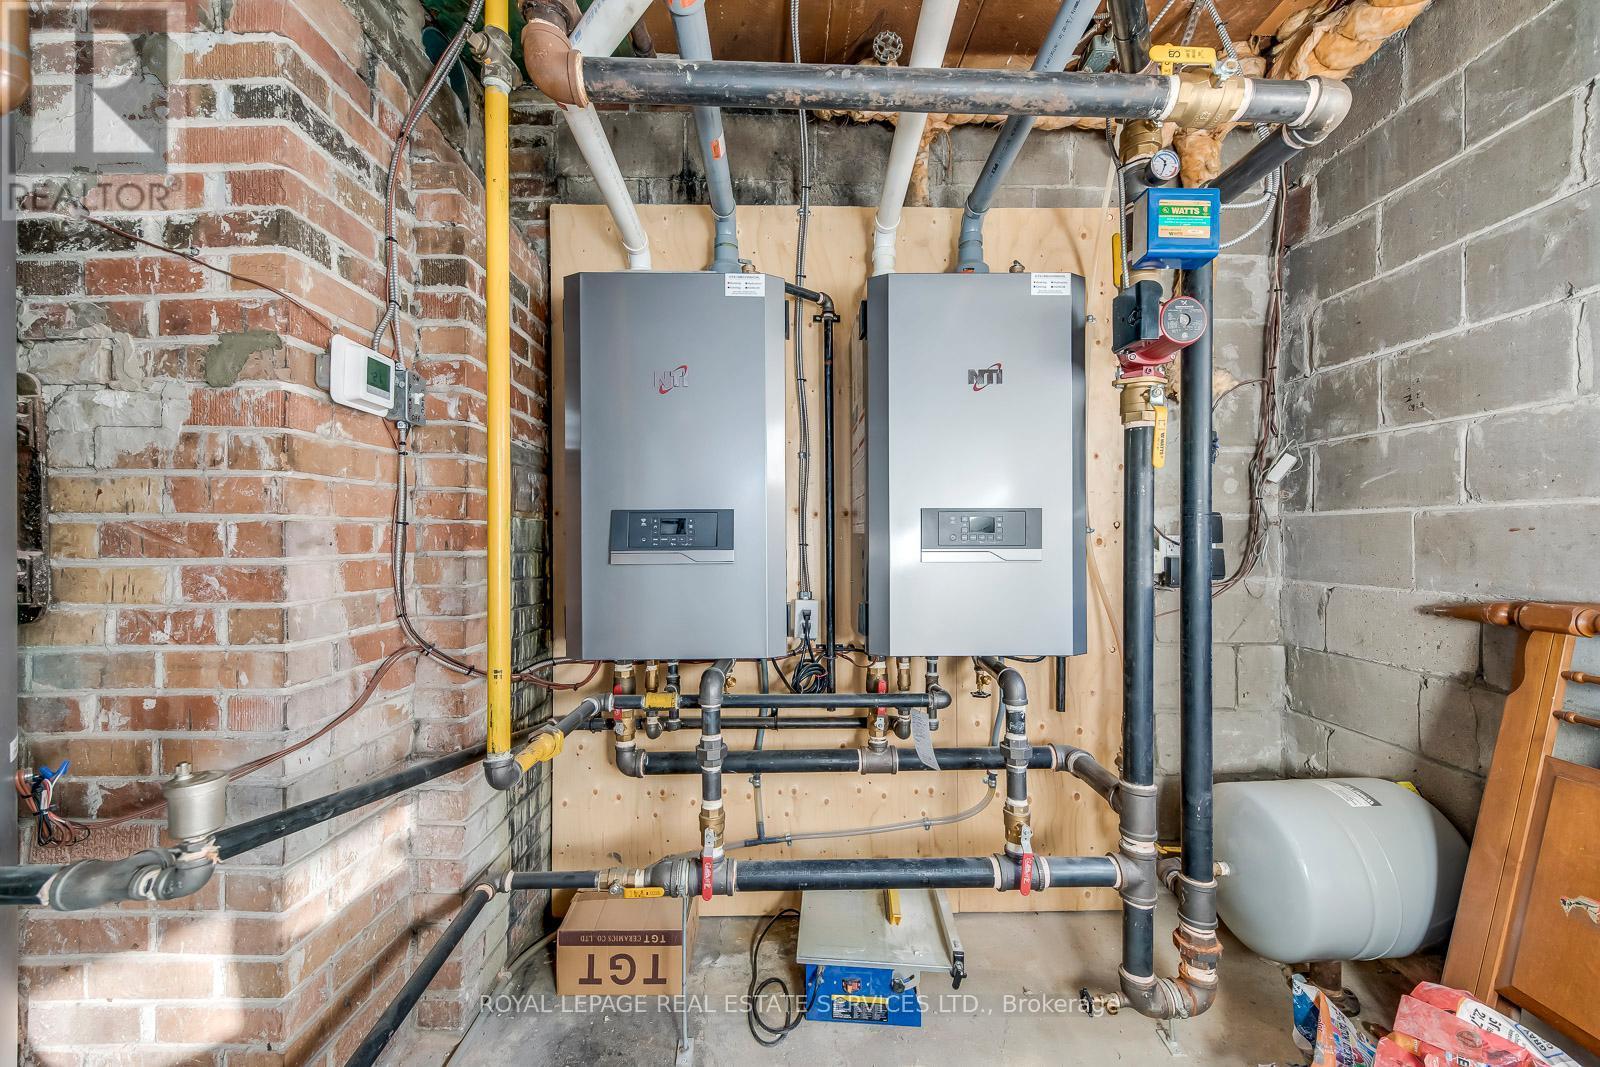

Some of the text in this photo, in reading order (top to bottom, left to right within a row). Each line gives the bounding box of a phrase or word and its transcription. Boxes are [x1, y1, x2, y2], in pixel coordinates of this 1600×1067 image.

[1171, 207, 1200, 215] WATTS
[968, 367, 1002, 386] NTI
[608, 935, 642, 943] CERAMICS
[644, 934, 666, 943] TGT
[578, 953, 667, 986] TGT
